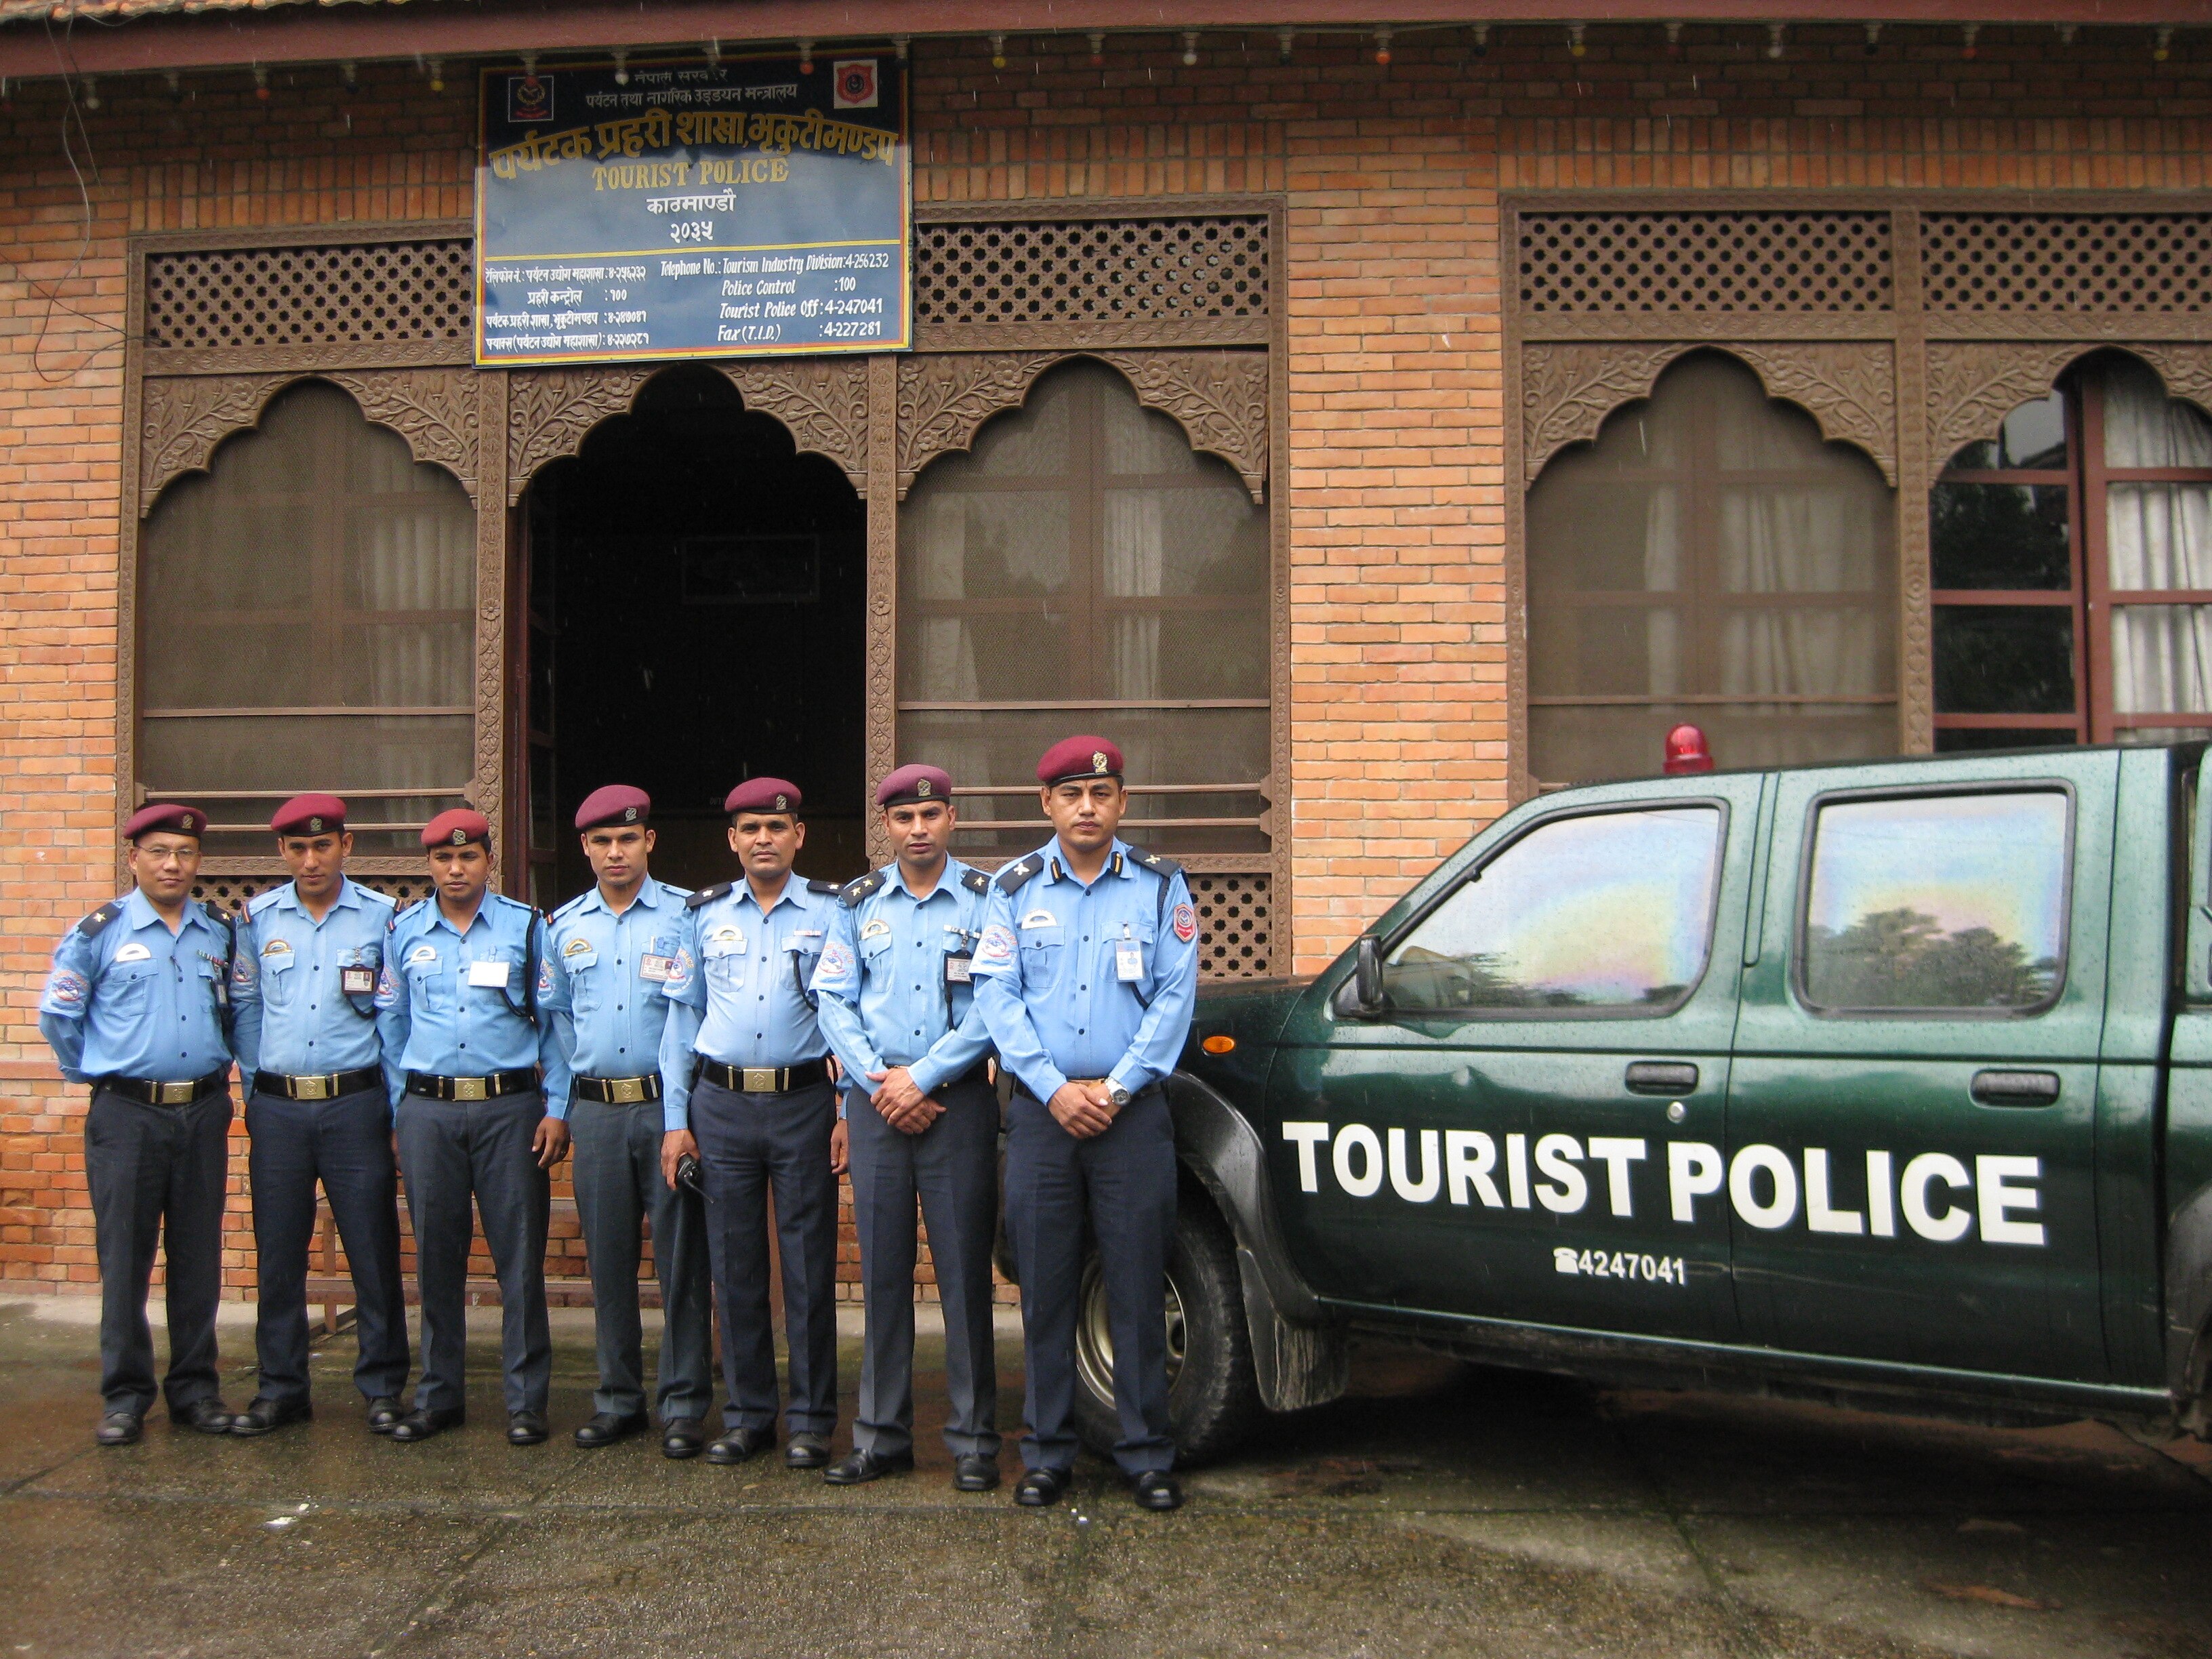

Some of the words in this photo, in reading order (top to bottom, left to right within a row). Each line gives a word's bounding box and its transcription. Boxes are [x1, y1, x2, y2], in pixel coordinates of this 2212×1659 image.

[586, 91, 618, 108] पर्यटन
[621, 93, 643, 108] तथा
[489, 127, 592, 180] पर्यटक
[594, 107, 673, 161] प्रहरी
[592, 161, 691, 191] TOURIST
[699, 158, 790, 185] POLICE
[646, 188, 737, 215] काठमाण्डौ
[670, 221, 714, 244] २०३५
[525, 266, 550, 283] पर्यटन
[660, 260, 701, 280] Telephone
[722, 257, 759, 274] Tourism
[761, 256, 804, 274] Industry
[527, 289, 550, 308] प्रहरी
[721, 279, 753, 296] Police
[756, 279, 796, 295] Control
[485, 312, 509, 329] पर्यटक
[509, 311, 531, 331] प्रहरी
[720, 303, 760, 320] Tourist
[764, 302, 796, 319] Police
[1282, 1120, 1645, 1218] TOURIST
[1667, 1141, 2045, 1246] POLICE
[1578, 1249, 1686, 1286] 4247041
